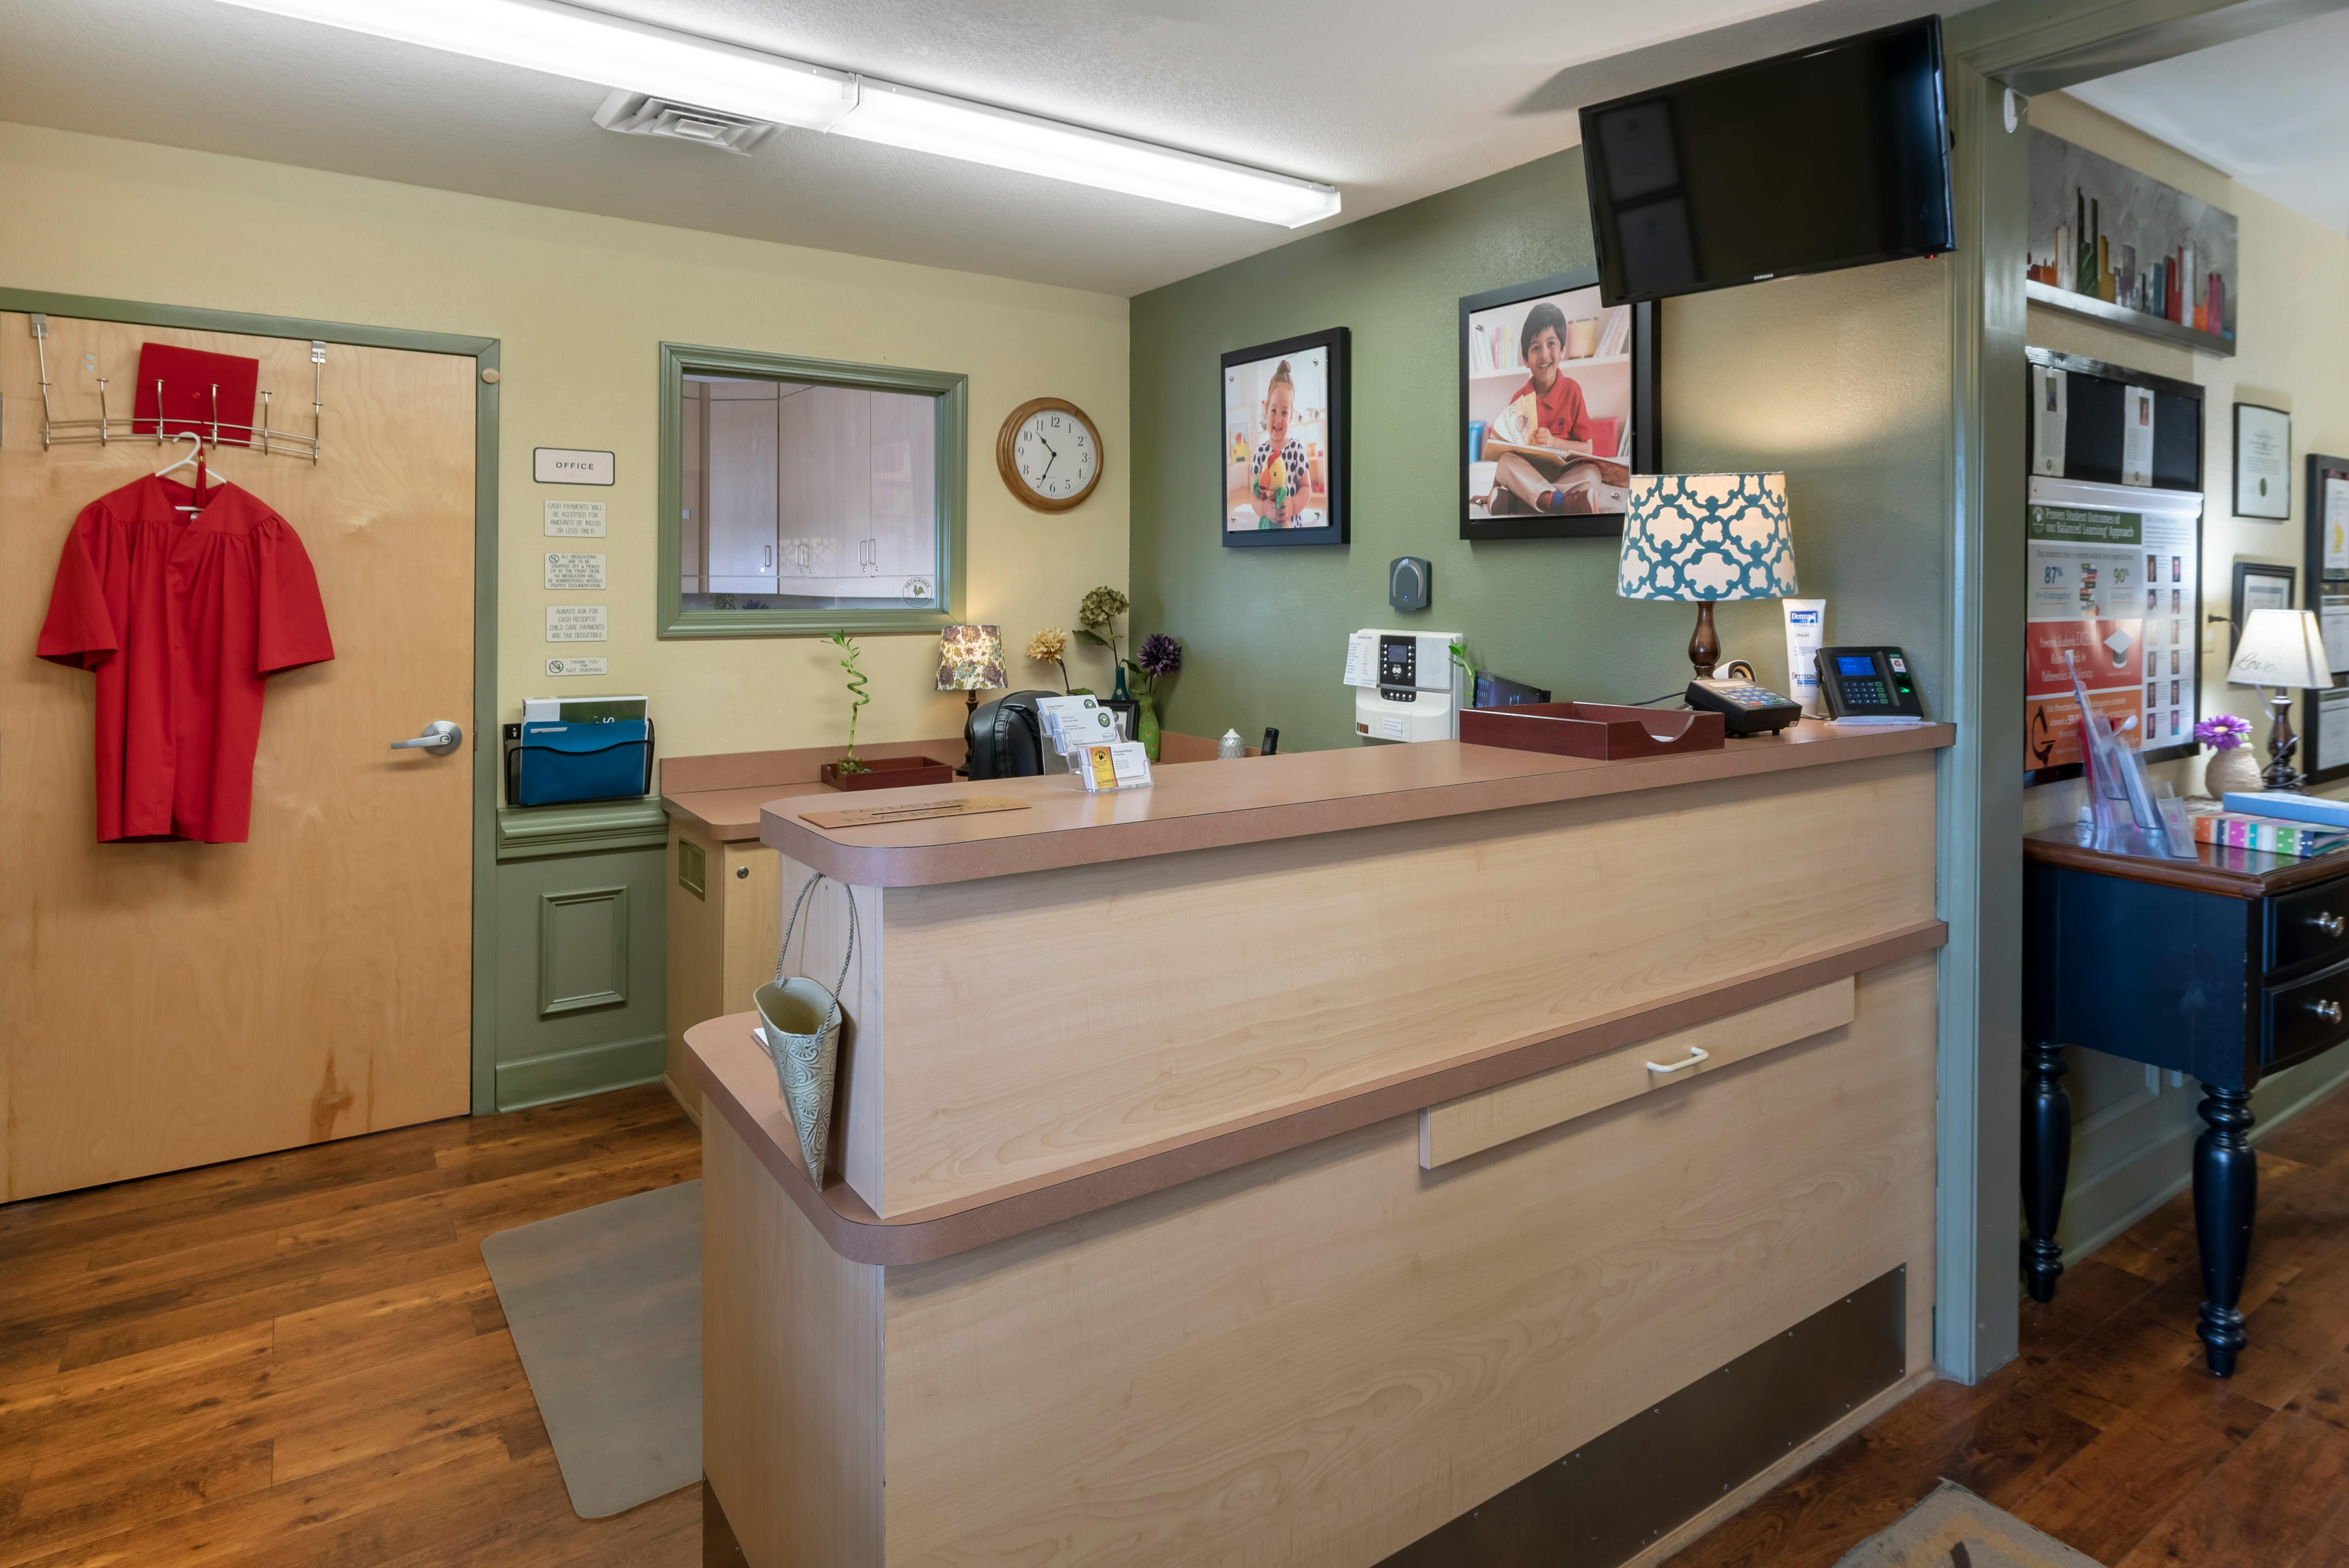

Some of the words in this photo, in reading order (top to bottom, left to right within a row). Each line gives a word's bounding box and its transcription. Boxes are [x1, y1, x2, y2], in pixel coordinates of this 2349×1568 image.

[1037, 420, 1043, 431] 11
[1051, 416, 1060, 427] 12
[1024, 431, 1032, 442] 10
[1077, 436, 1083, 446] 2
[1018, 447, 1024, 457] 9
[1082, 452, 1087, 463] 3
[1023, 465, 1029, 475] 8
[1077, 469, 1082, 478] 4
[1036, 478, 1040, 488] 7
[1050, 482, 1055, 493] 6
[1065, 480, 1070, 490] 5
[2045, 508, 2065, 520] Proven
[2066, 510, 2087, 521] Student
[2088, 512, 2114, 524] Outcomes
[2115, 514, 2120, 524] of
[2046, 524, 2056, 532] our
[2057, 522, 2082, 534] Balanced
[2109, 526, 2134, 539] Approach
[2044, 567, 2063, 584] 87%
[2114, 567, 2130, 584] 90%
[905, 579, 930, 589] PRIMROSE
[2235, 651, 2277, 672] Love
[840, 799, 970, 814] PAYMENTS
[840, 811, 934, 822] THANK
